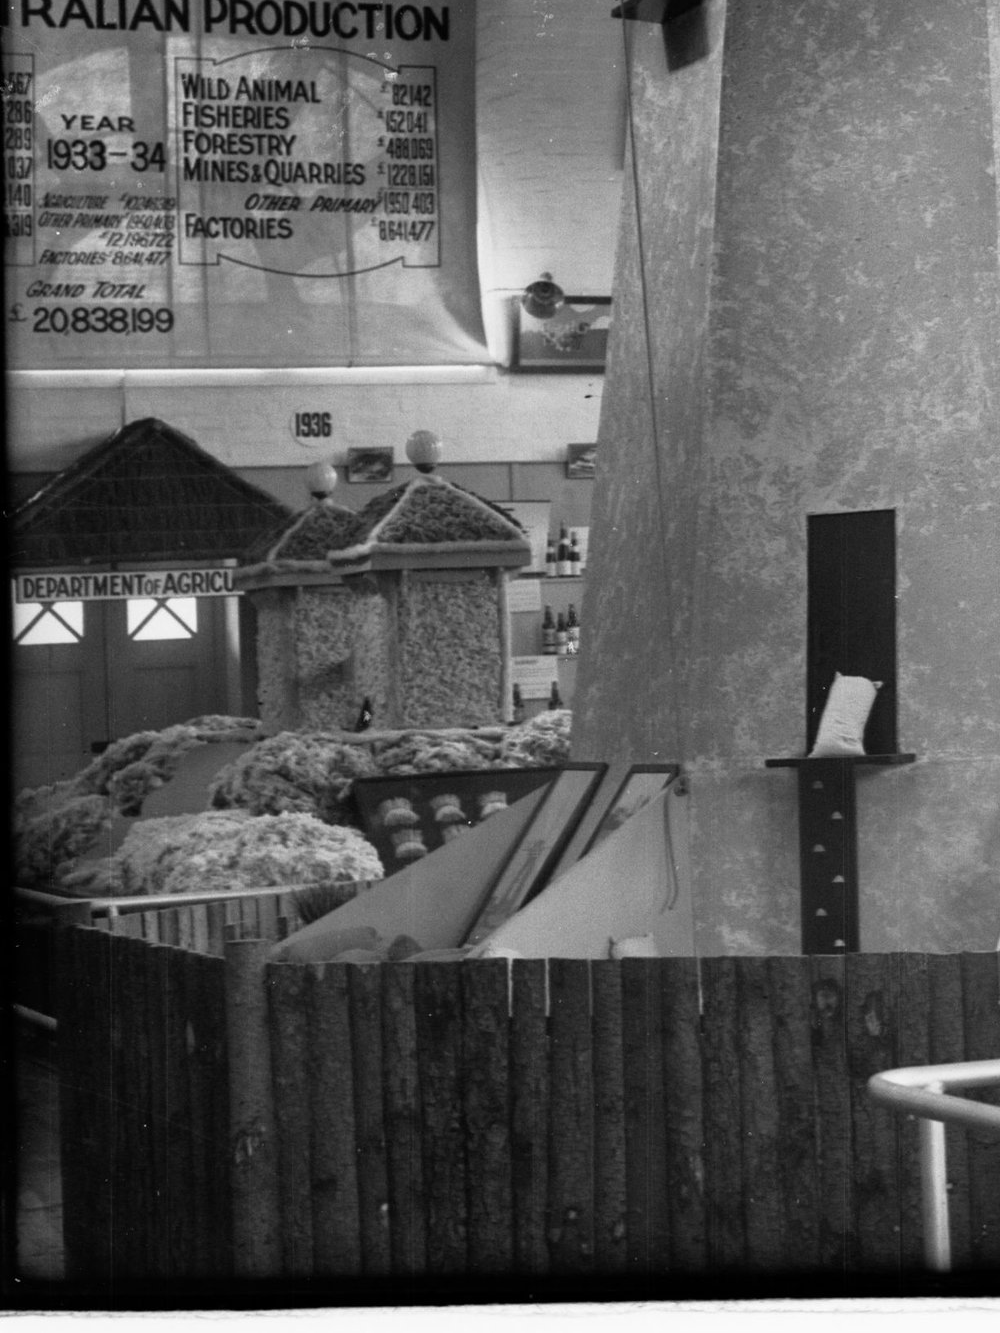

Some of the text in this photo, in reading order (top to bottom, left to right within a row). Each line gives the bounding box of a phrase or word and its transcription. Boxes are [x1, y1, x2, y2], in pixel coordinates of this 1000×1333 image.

[181, 73, 231, 101] WILD
[235, 76, 321, 104] ANIMAL
[61, 113, 136, 133] YEAR
[182, 101, 290, 130] FISHERIES
[183, 130, 297, 156] FORESTRY
[244, 193, 302, 212] OTHER
[310, 195, 383, 214] PRIMARY
[38, 211, 73, 228] OTHER
[73, 211, 123, 228] PRIMARY
[185, 213, 293, 240] FACTORIES
[39, 249, 107, 265] FACTORIES
[26, 280, 146, 299] GRAND TOTAL
[295, 412, 332, 437] 1936
[23, 573, 145, 599] DEPARTMENT
